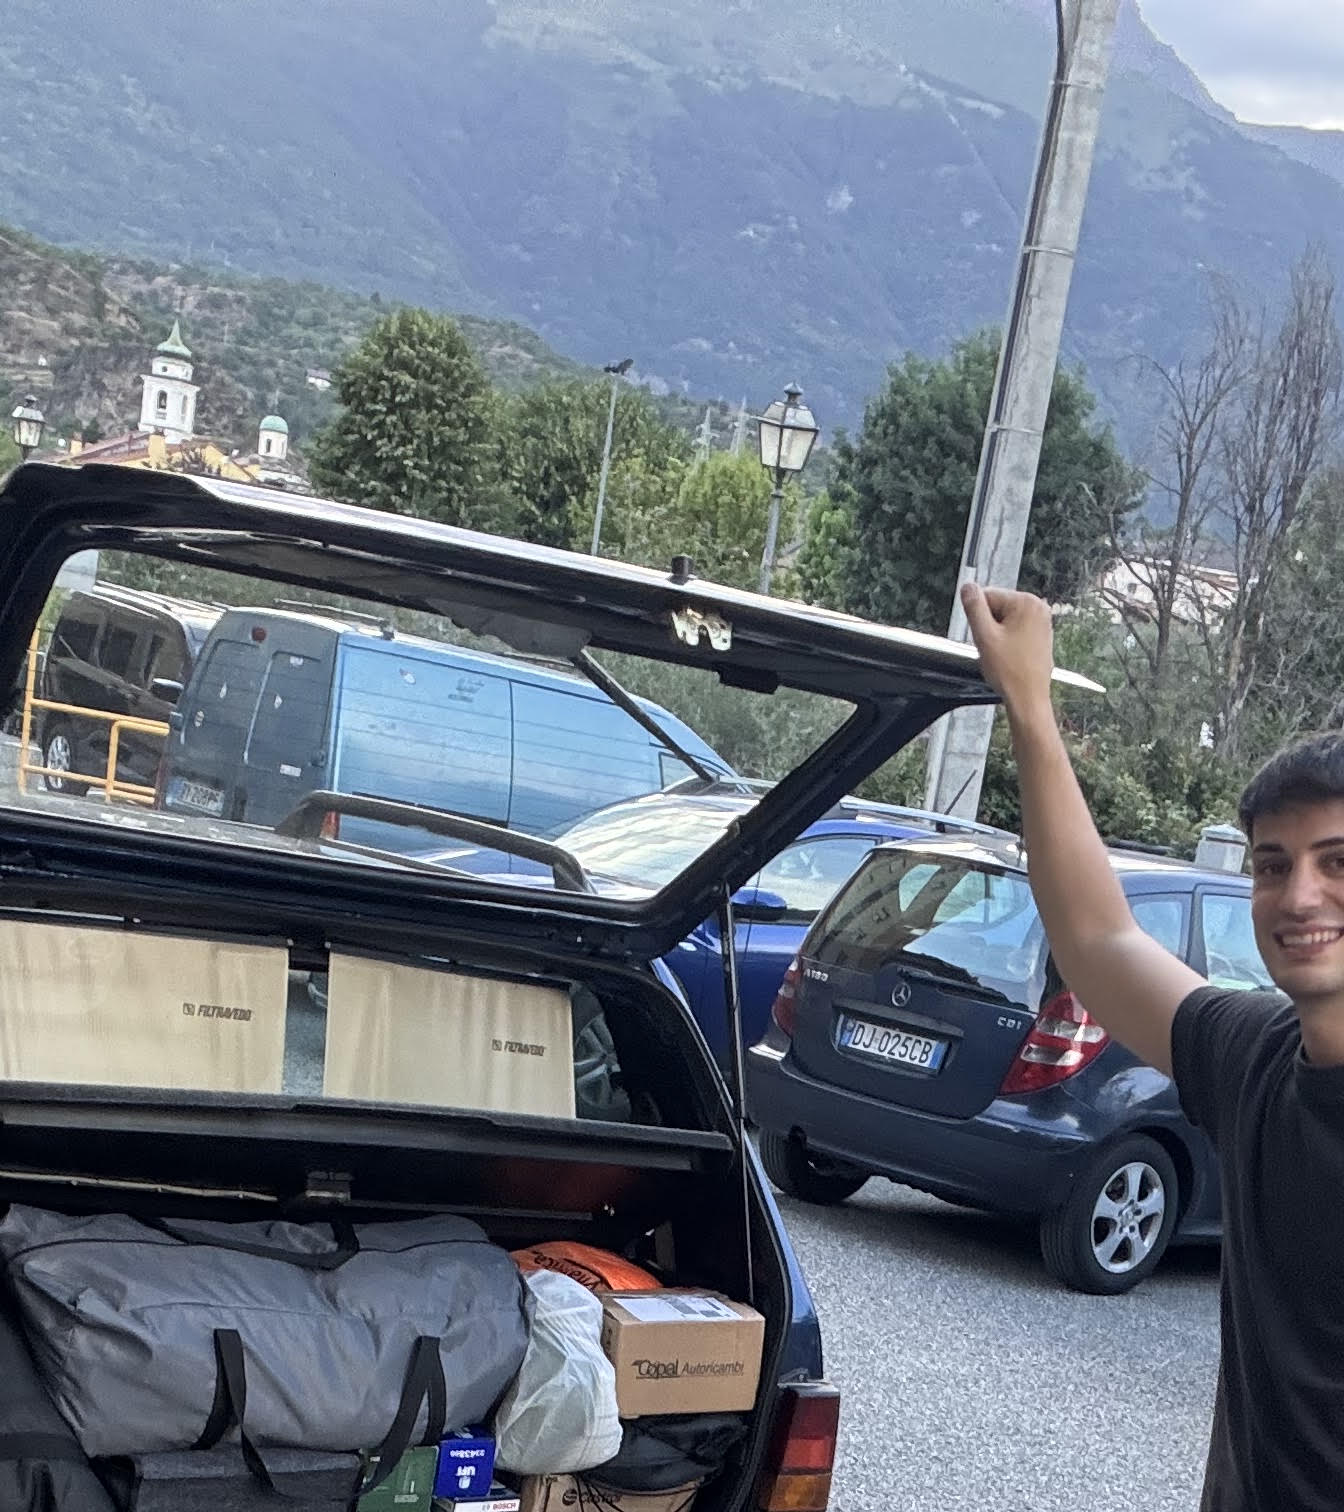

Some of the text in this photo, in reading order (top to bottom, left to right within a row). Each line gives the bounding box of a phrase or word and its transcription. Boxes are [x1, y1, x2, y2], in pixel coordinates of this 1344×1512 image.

[852, 1023, 933, 1064] DJ 025CB
[633, 1358, 745, 1379] Copal Autoricambi
[493, 1502, 517, 1512] BOSCH
